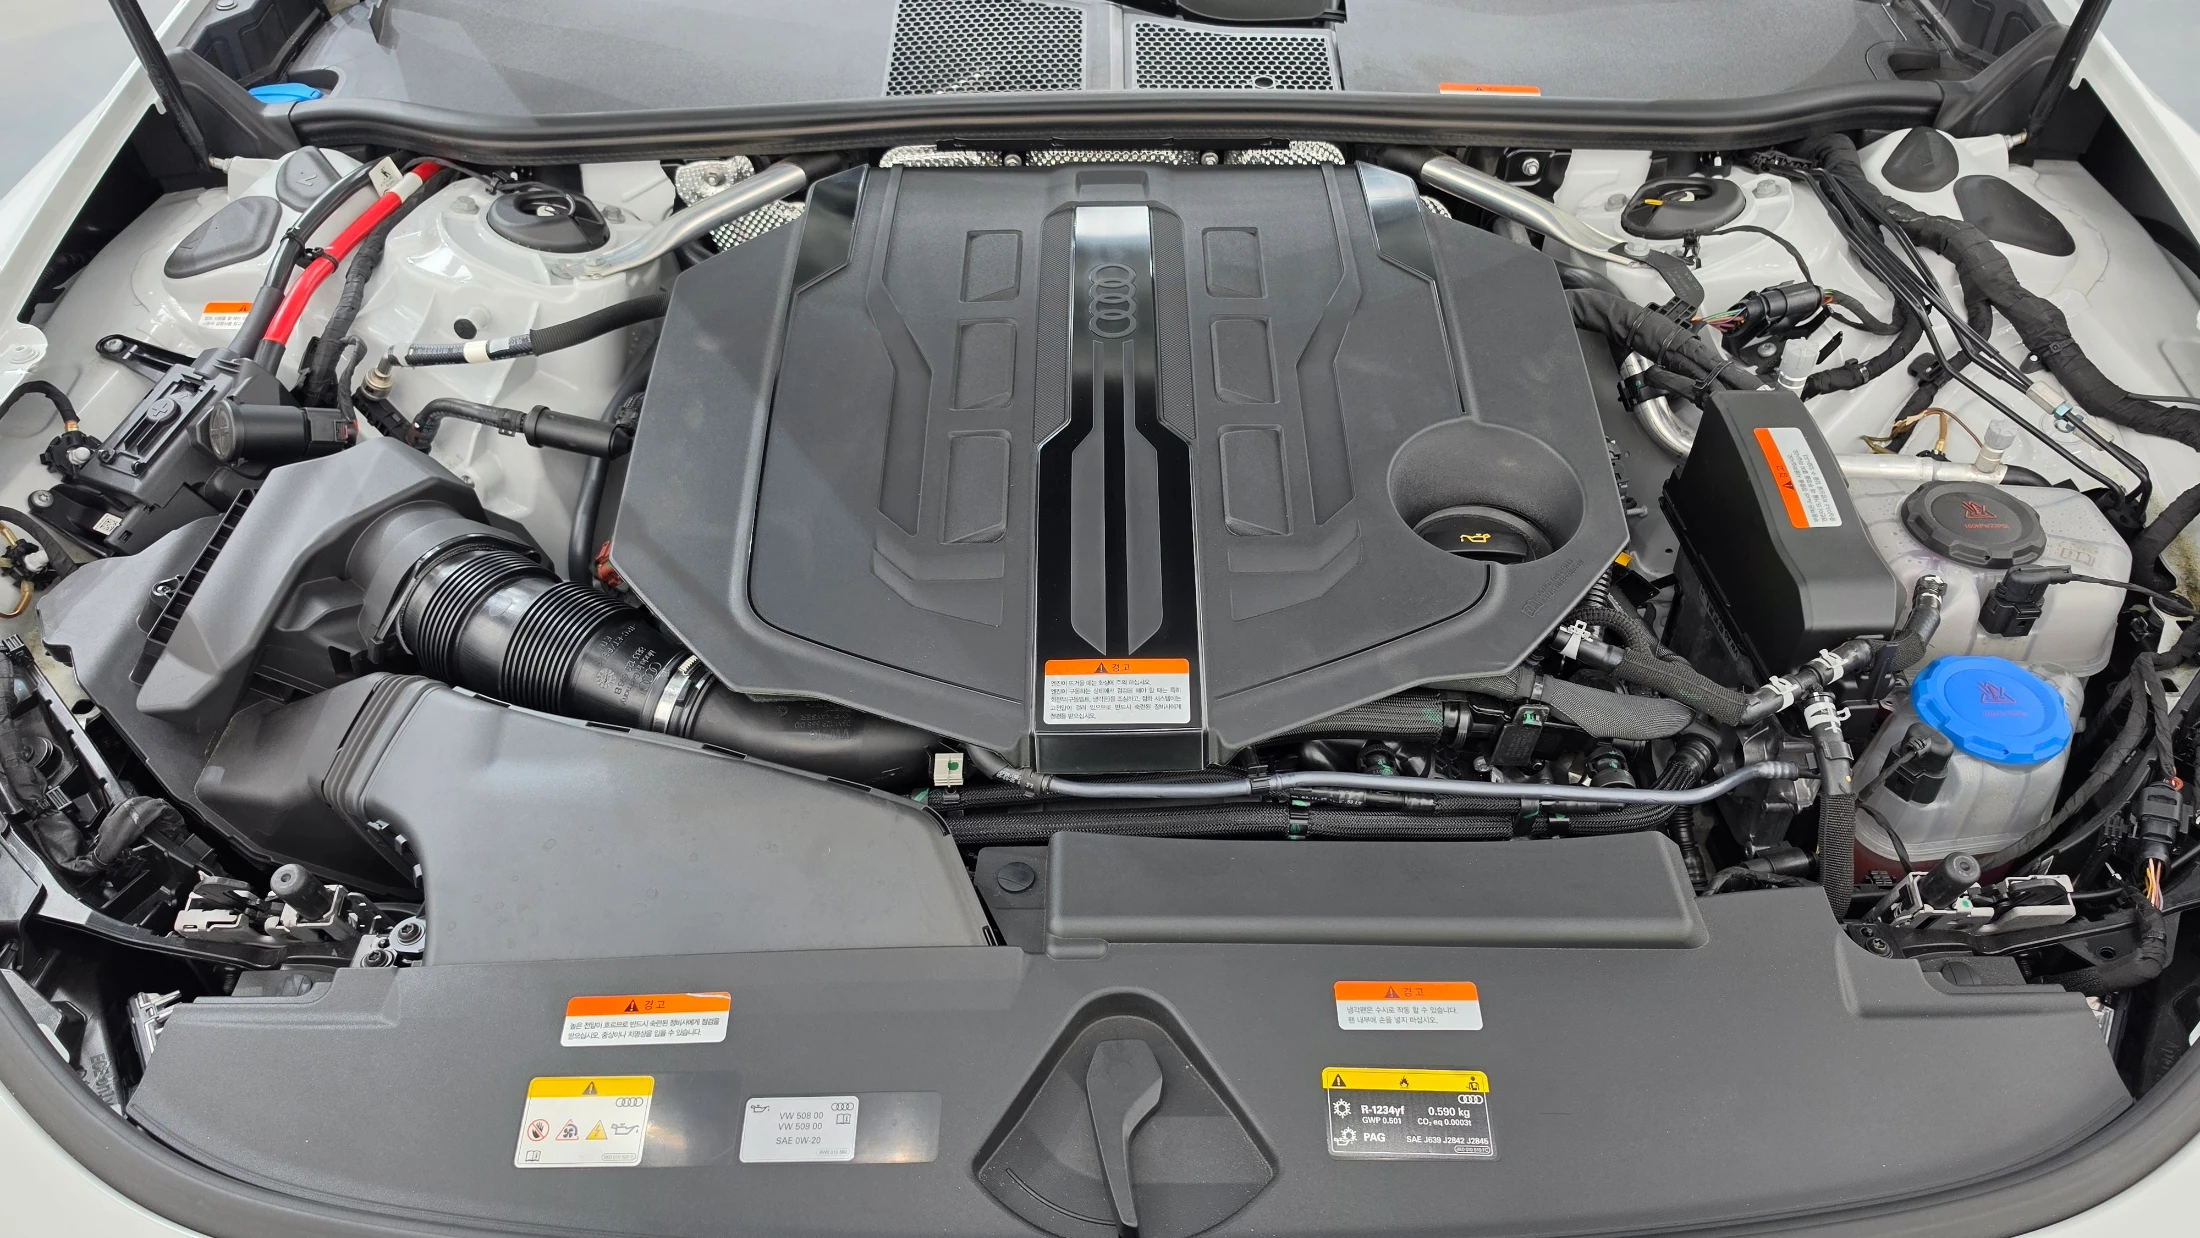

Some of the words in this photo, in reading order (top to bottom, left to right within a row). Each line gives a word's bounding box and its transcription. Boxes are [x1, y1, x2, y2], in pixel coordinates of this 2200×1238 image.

[1347, 1006, 1373, 1014] 냉각팬은
[1375, 1006, 1395, 1014] 수시로
[1397, 1006, 1410, 1014] 작동
[1413, 1006, 1419, 1014] 할
[1421, 1006, 1428, 1014] 수
[1430, 1006, 1459, 1014] 있습니다.
[584, 1021, 602, 1029] 전압이
[630, 1020, 648, 1028] 반드시
[650, 1019, 668, 1027] 숙련된
[670, 1018, 700, 1027] 정비사에게
[702, 1018, 719, 1026] 점검을
[1348, 1016, 1355, 1024] 팬
[1357, 1016, 1377, 1024] 내부에
[1379, 1016, 1392, 1024] 손을
[1394, 1016, 1408, 1024] 넣지
[601, 1031, 627, 1039] 중상이나
[628, 1030, 652, 1038] 치명상을
[654, 1029, 666, 1037] 입을
[1361, 1105, 1405, 1116] R-1234yf
[1428, 1106, 1456, 1116] 0.590
[1458, 1107, 1470, 1118] kg
[780, 1112, 794, 1120] VW
[813, 1122, 822, 1130] 00
[1444, 1119, 1472, 1127] 0.0003t
[1364, 1133, 1386, 1142] PAG
[1406, 1135, 1422, 1143] SAE
[1443, 1136, 1465, 1144] J2842
[1466, 1137, 1489, 1145] J2845
